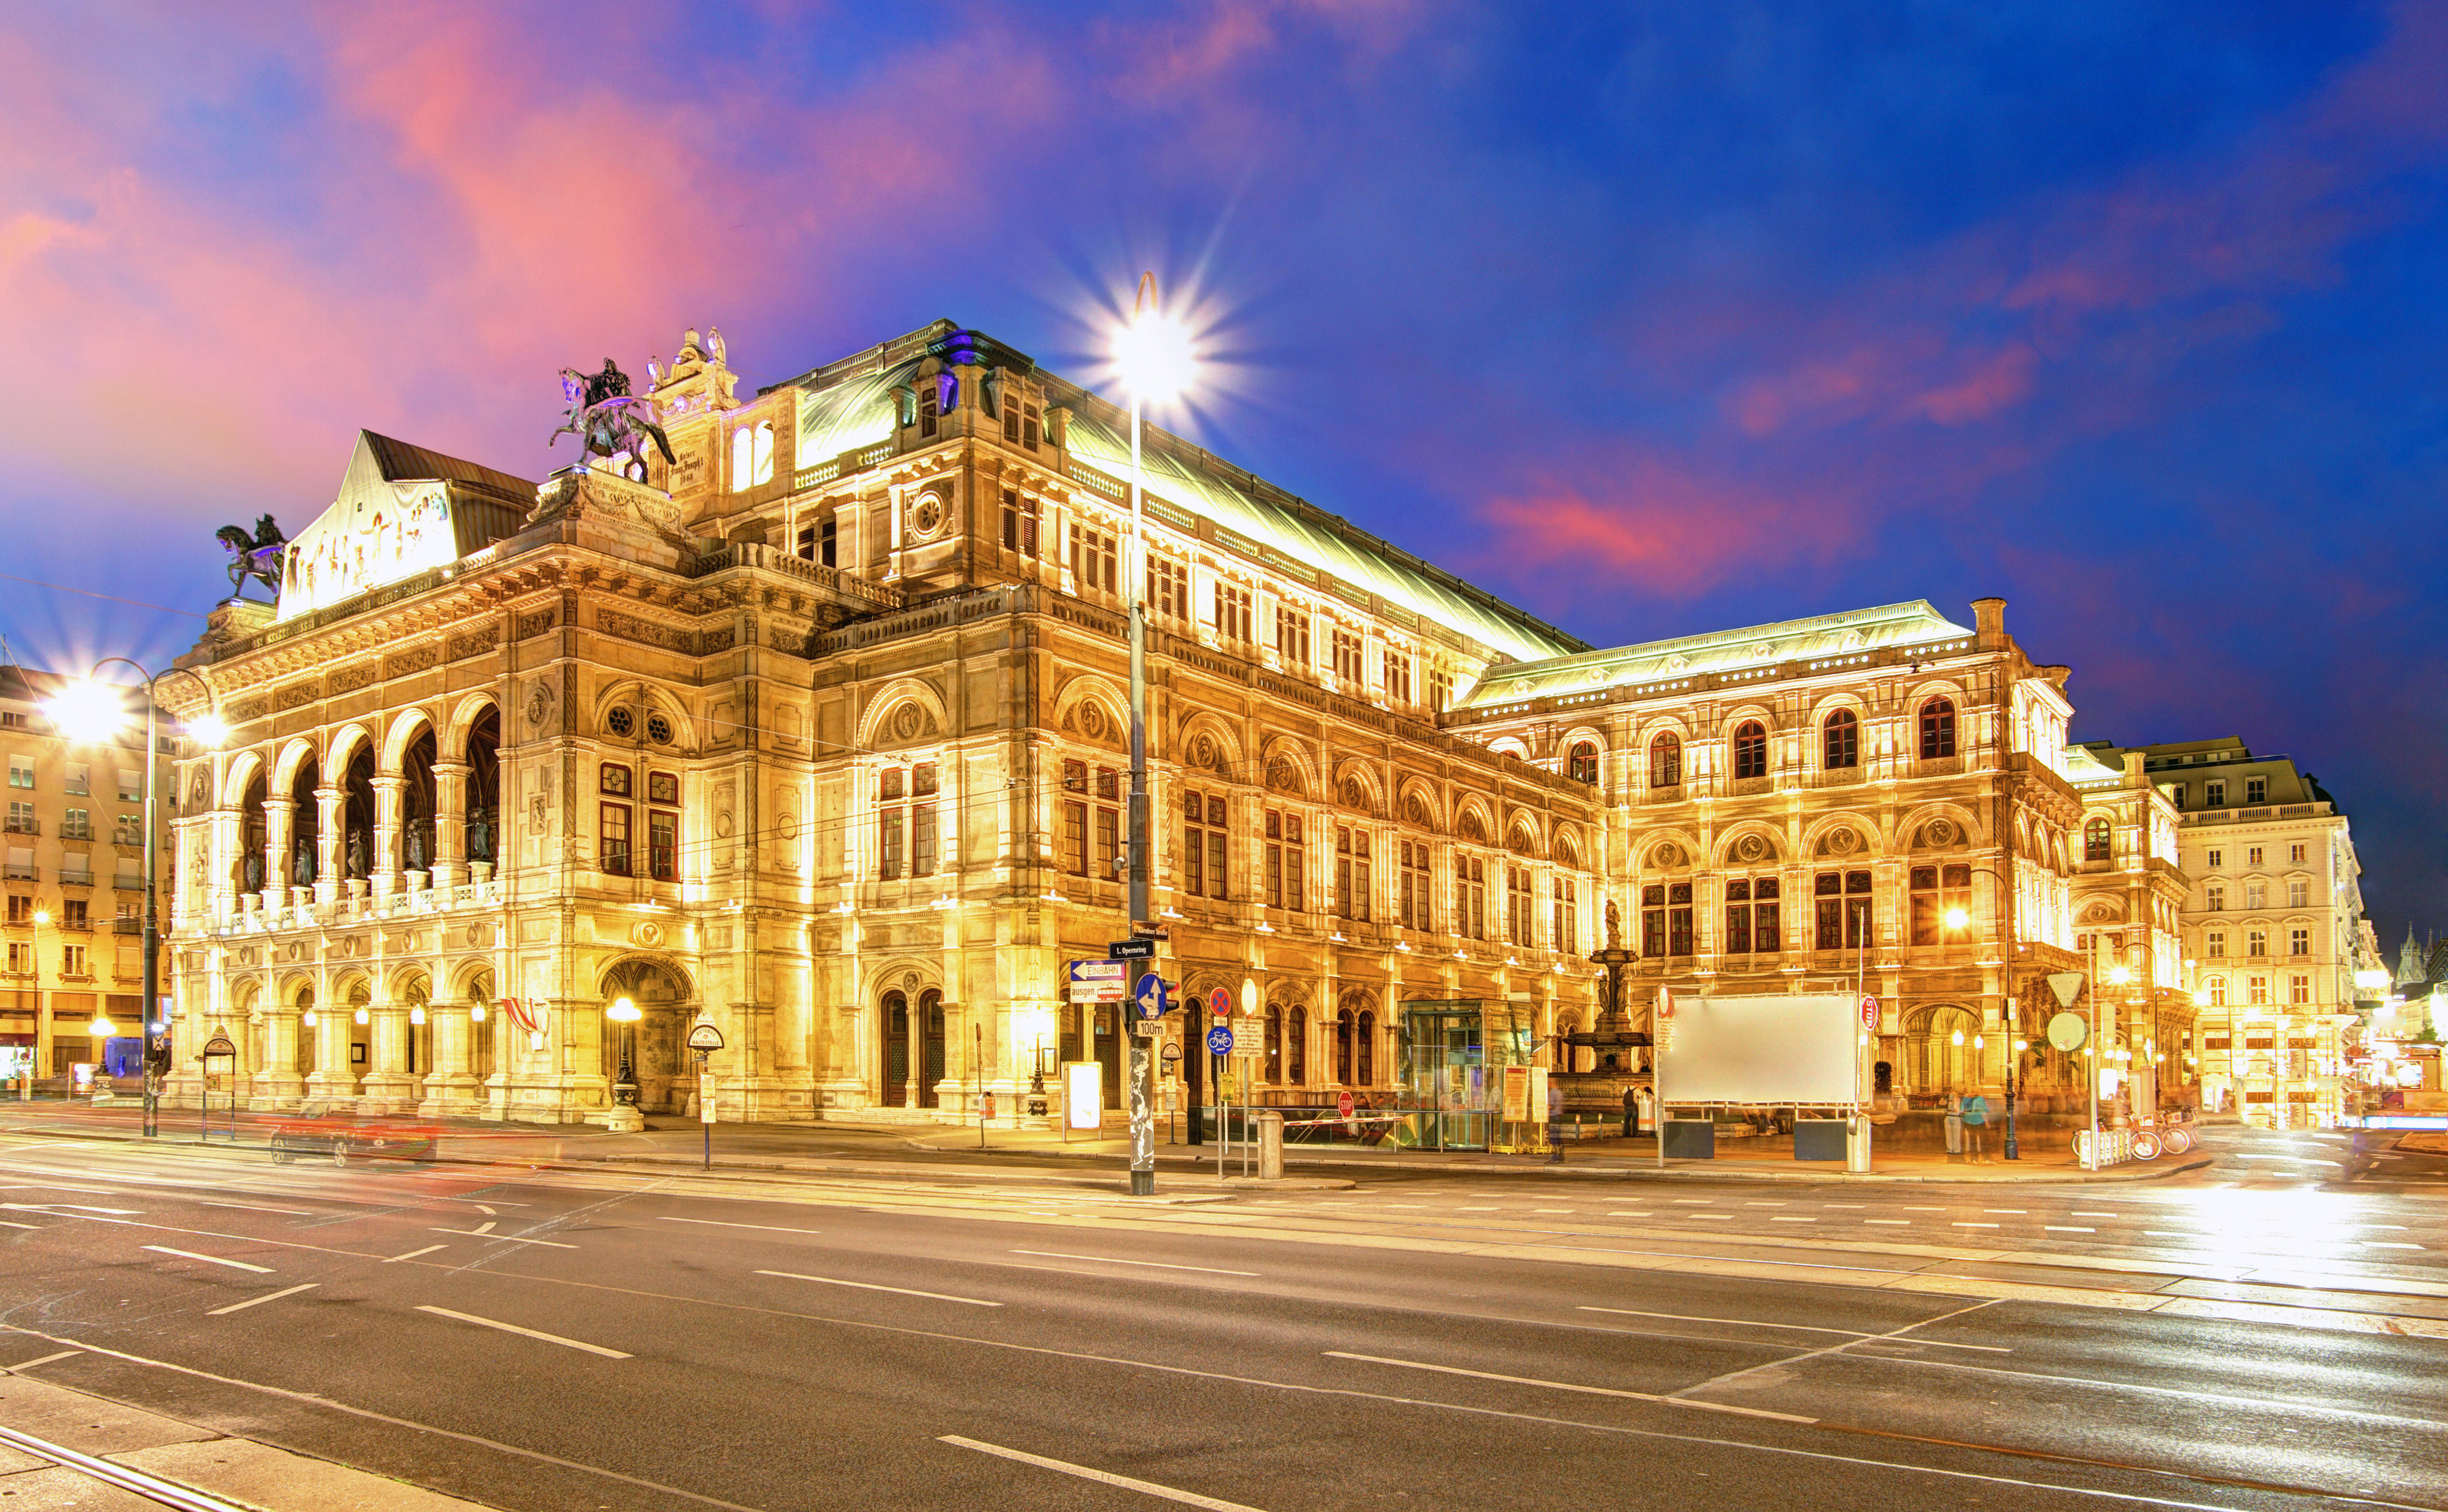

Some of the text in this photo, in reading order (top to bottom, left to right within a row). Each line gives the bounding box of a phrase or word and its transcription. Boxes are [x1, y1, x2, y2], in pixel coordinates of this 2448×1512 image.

[680, 473, 693, 486] 1868
[1155, 928, 1168, 936] Straße
[1122, 946, 1146, 956] Opernring
[1087, 965, 1118, 975] EINBAHN
[1072, 988, 1096, 998] ausgen.
[696, 1028, 716, 1037] AUTOBUS
[1141, 1023, 1163, 1034] 100m
[1340, 1099, 1352, 1110] STOP
